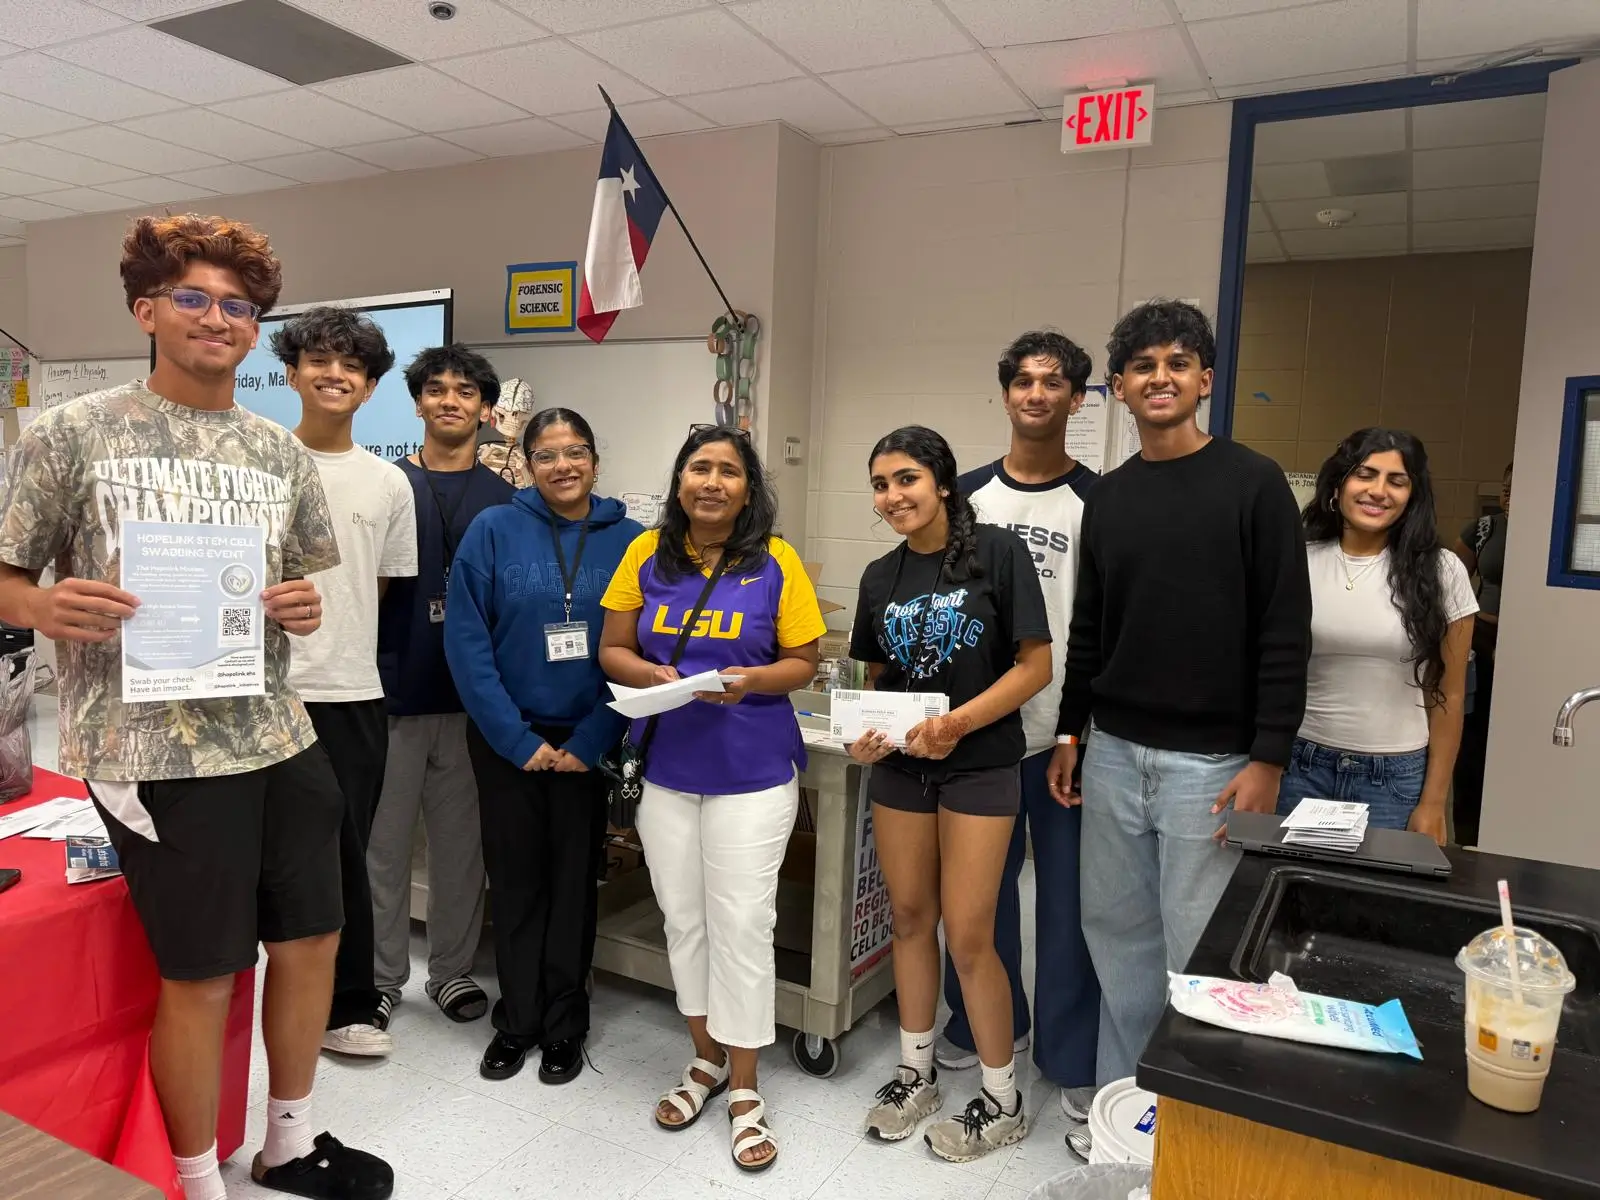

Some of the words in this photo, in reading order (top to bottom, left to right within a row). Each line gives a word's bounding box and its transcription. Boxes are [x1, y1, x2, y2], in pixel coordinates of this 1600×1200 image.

[1076, 90, 1142, 145] EXIT
[518, 283, 563, 295] FORENSIC
[520, 302, 559, 313] SCIENCE
[234, 373, 264, 392] riday,
[387, 442, 410, 457] not
[93, 457, 214, 500] ULTIMATE
[136, 533, 195, 546] HOPELINK
[196, 536, 228, 546] STEM
[230, 537, 257, 547] CELL
[141, 547, 206, 558] SWABBING
[206, 549, 245, 560] EVENT
[652, 604, 744, 640] LSU
[883, 602, 921, 624] Cross
[129, 678, 152, 686] Swab
[153, 678, 171, 687] your
[172, 676, 197, 684] cheek.
[129, 686, 150, 694] Have
[163, 684, 192, 693] impact.
[854, 888, 890, 922] REGIS
[853, 919, 869, 941] TO
[872, 908, 886, 930] BE
[850, 931, 878, 961] CELL
